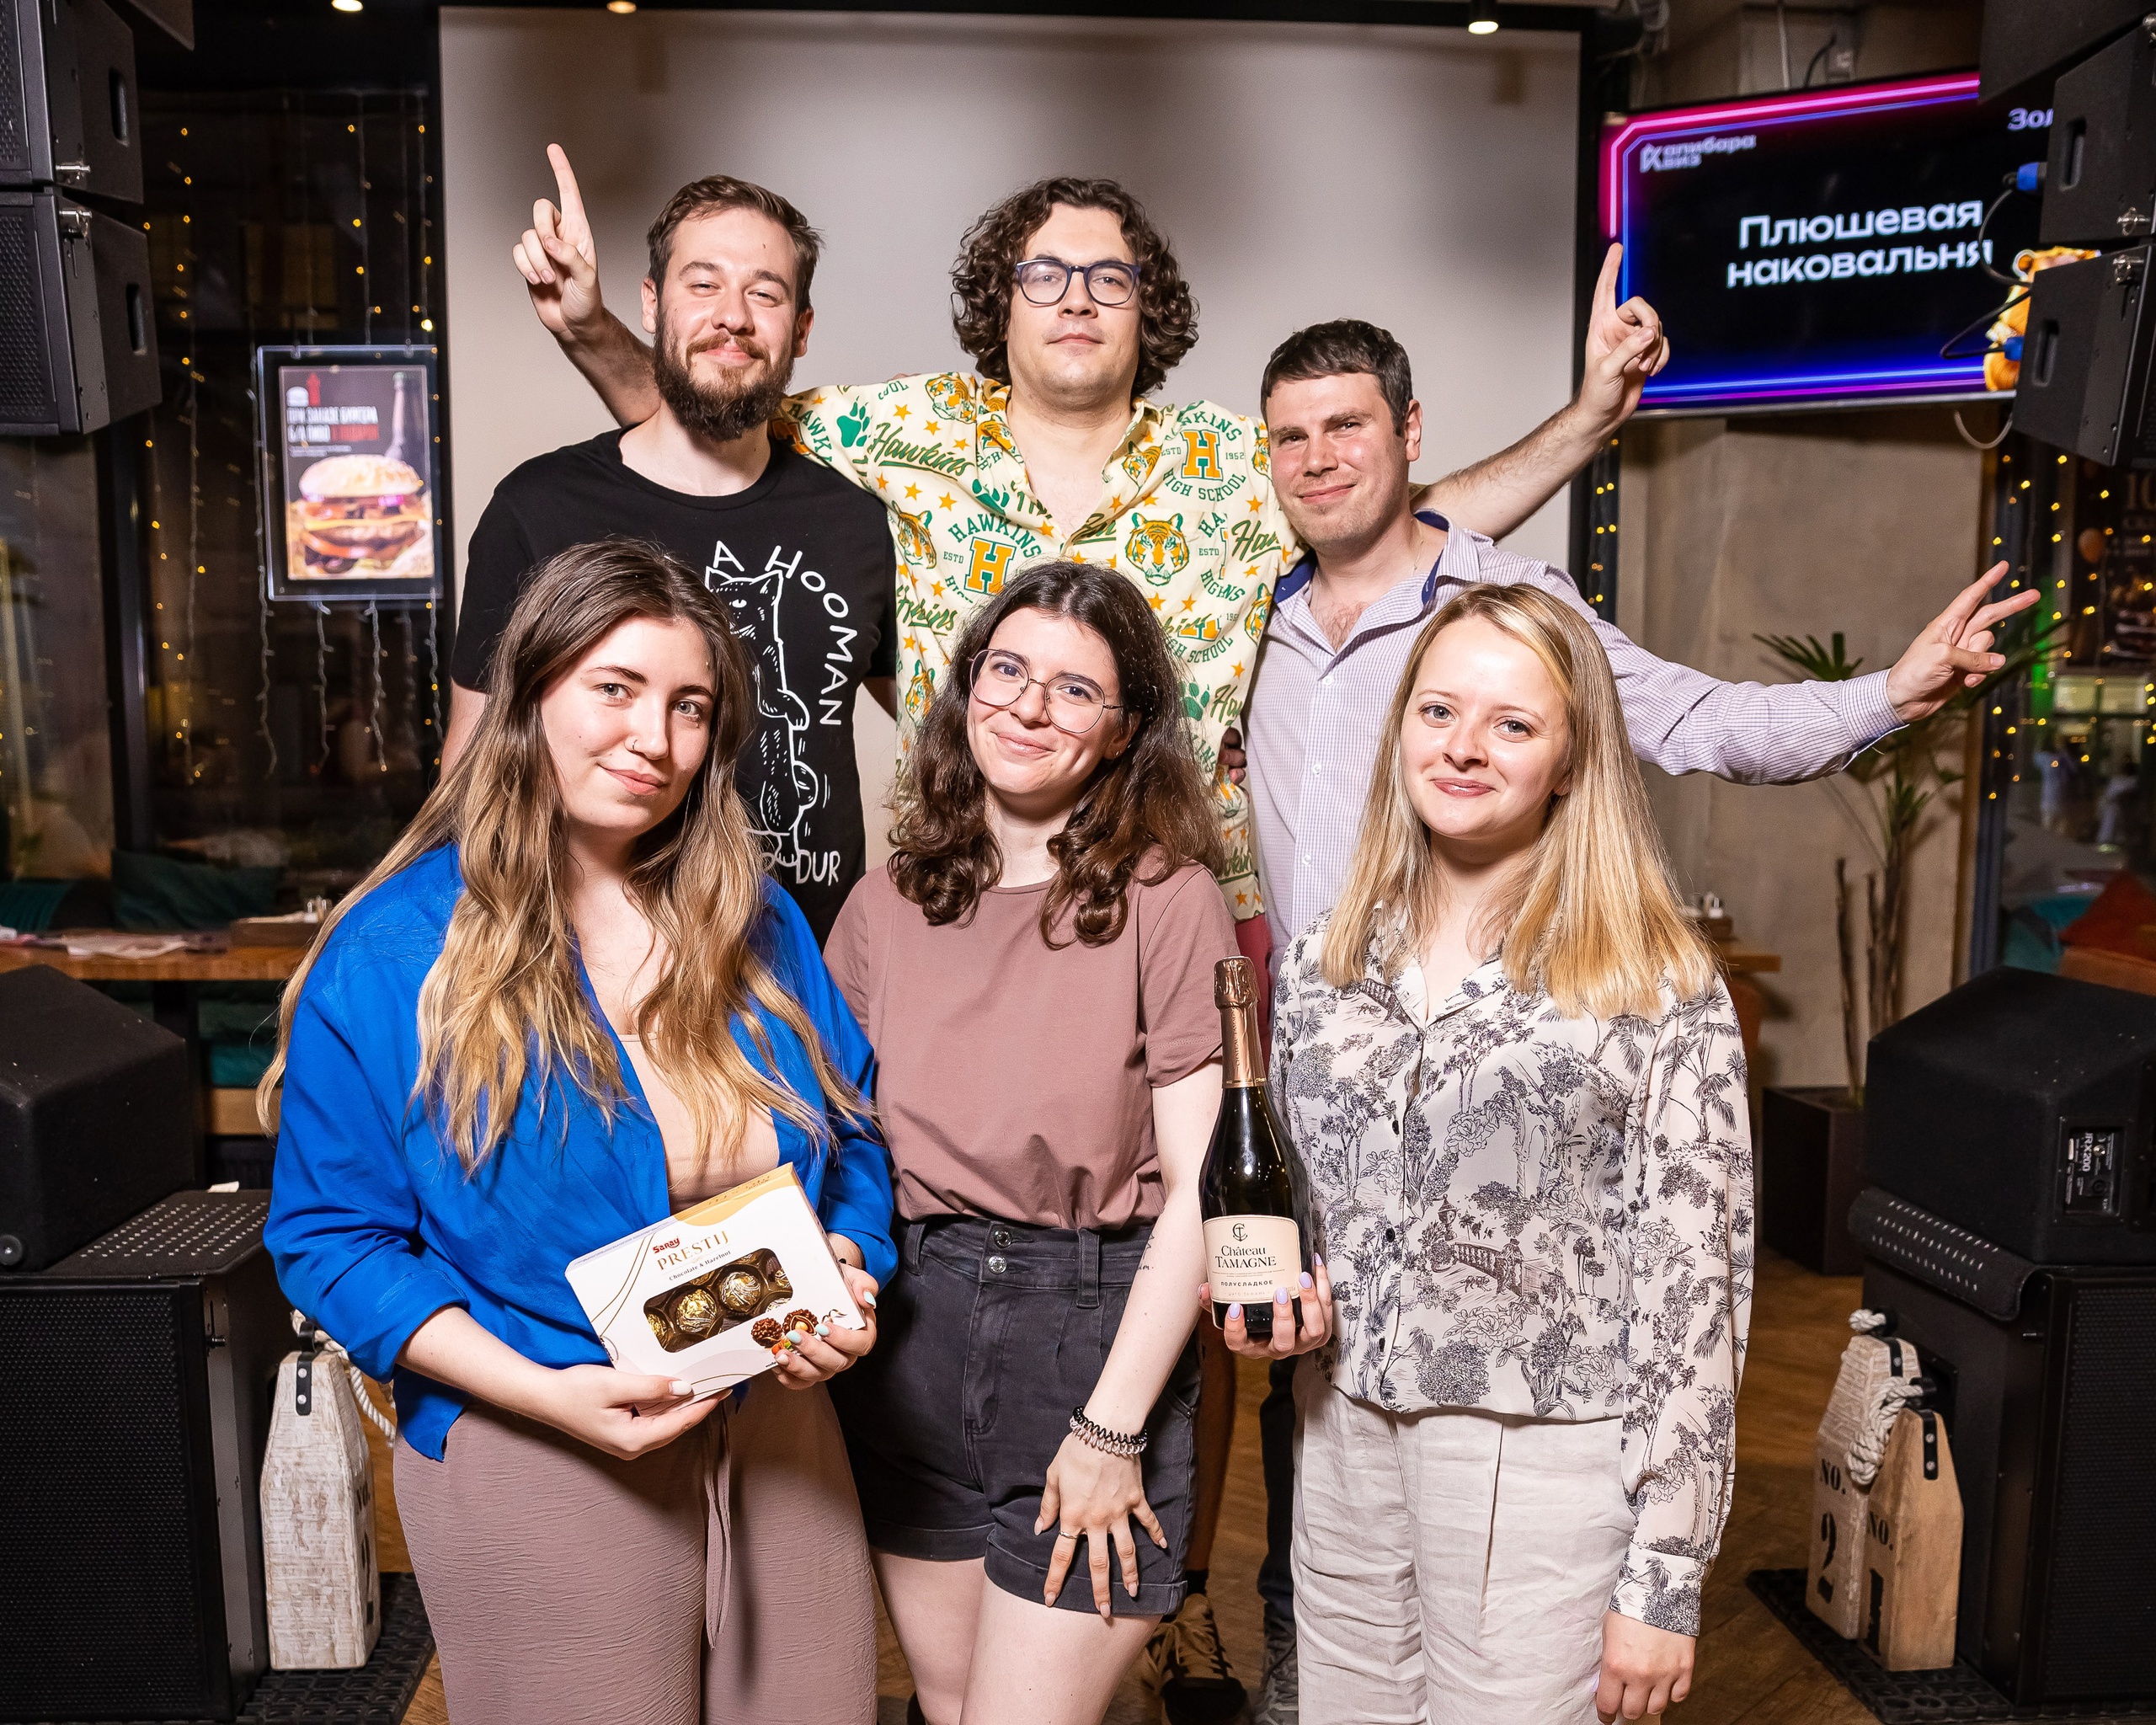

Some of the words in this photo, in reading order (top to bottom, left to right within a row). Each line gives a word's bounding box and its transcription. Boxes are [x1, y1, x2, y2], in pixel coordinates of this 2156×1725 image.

[1738, 200, 1983, 250] Плюшевая
[1726, 239, 1994, 288] наковальня
[867, 422, 976, 477] Hawkins
[1198, 473, 1246, 503] SCHOOL
[947, 513, 1043, 558] HAWKINS
[1198, 547, 1220, 557] ESTD
[942, 550, 964, 564] ESTD
[712, 540, 745, 572] A
[765, 544, 858, 726] HOOMAN
[1187, 635, 1235, 664] SCHOOL
[652, 1237, 680, 1254] Saray
[657, 1231, 729, 1271] PRESTIJ
[1214, 1255, 1277, 1268] TAMAGNE
[669, 1265, 699, 1281] Chocolate
[704, 1250, 731, 1266] Hazelnut
[1817, 1513, 1837, 1605] 2
